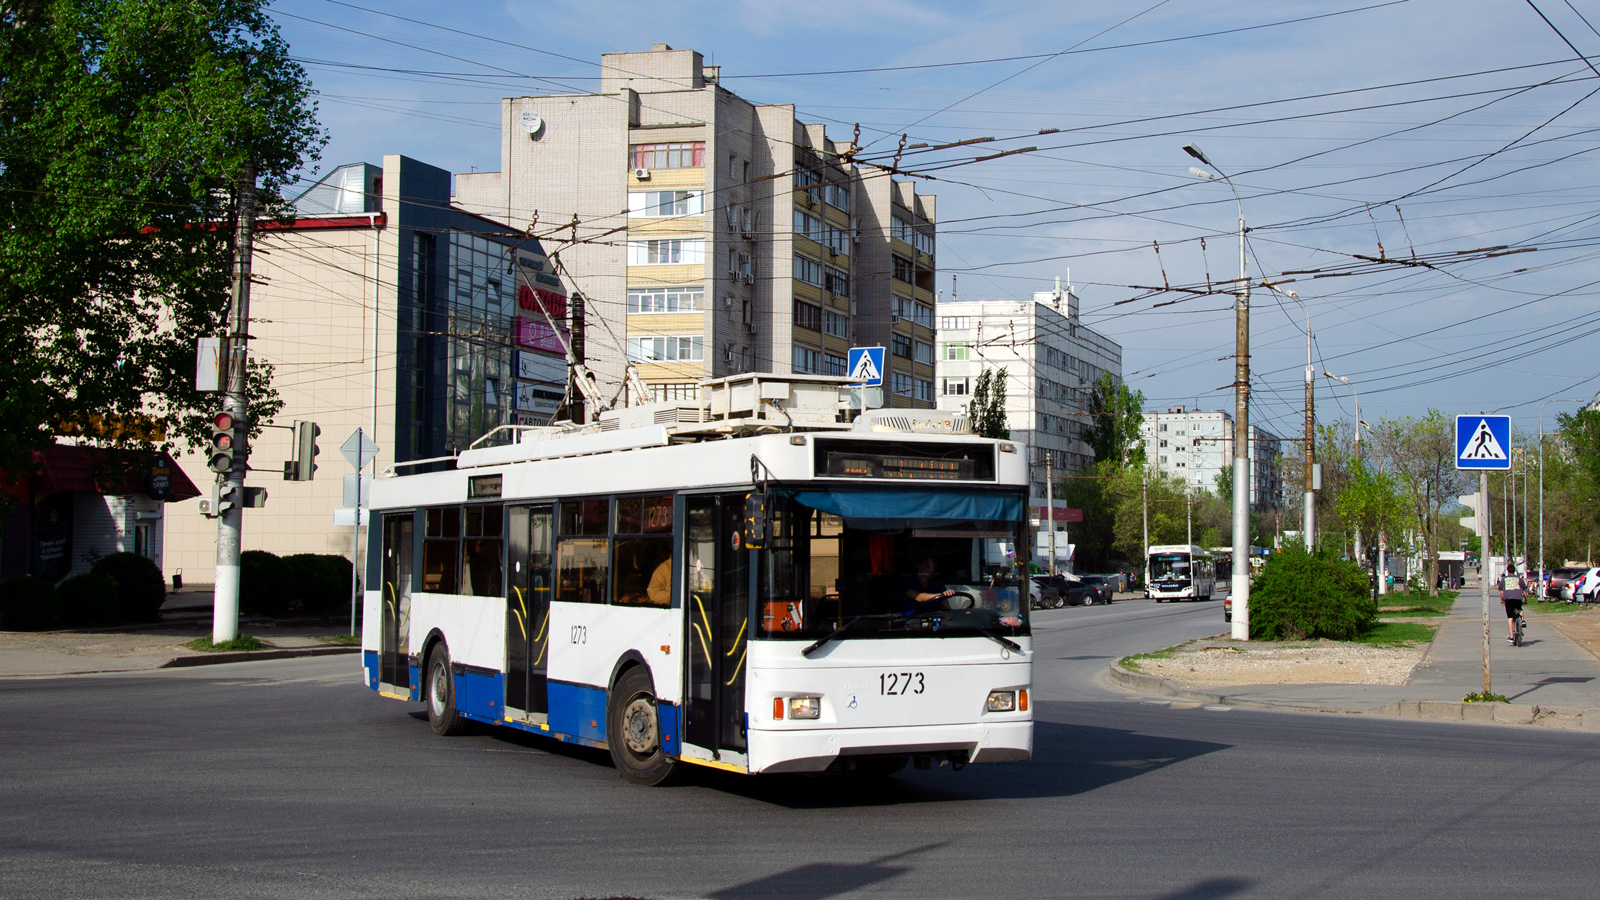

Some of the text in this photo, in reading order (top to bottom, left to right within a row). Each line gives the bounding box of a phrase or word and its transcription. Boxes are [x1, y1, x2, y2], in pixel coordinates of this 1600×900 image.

[648, 505, 668, 528] 1273
[570, 625, 587, 645] 1273
[880, 672, 925, 695] 1273
